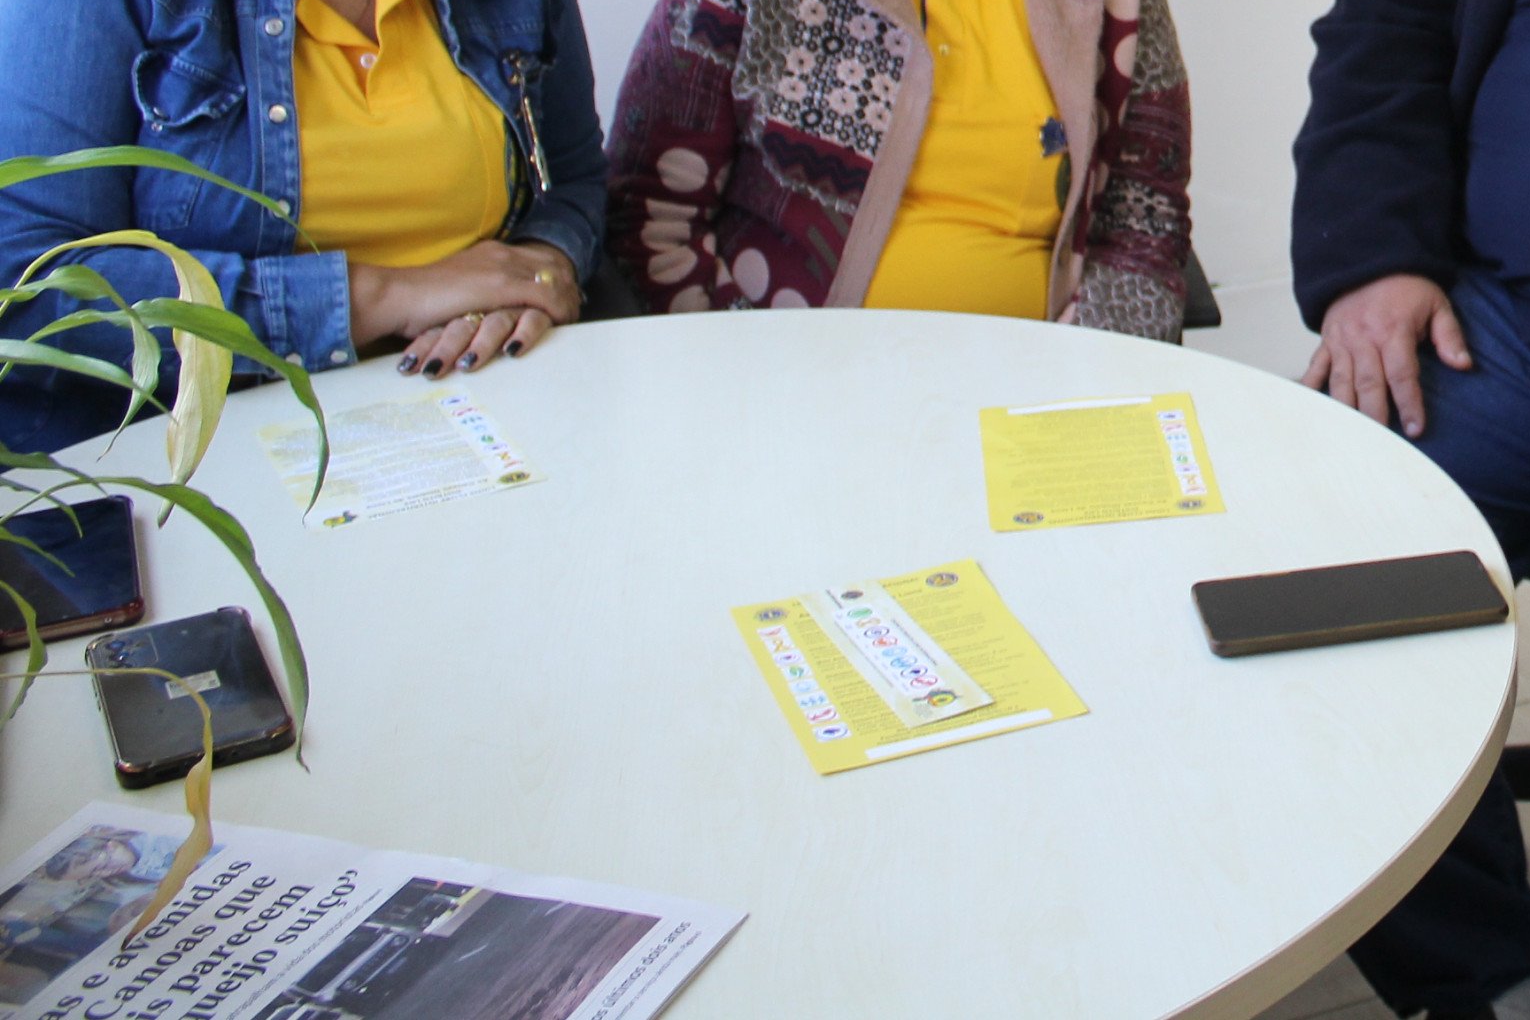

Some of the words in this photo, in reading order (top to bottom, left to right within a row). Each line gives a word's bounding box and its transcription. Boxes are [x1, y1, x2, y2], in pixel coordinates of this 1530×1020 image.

[82, 973, 111, 989] e
[109, 860, 252, 970] avenidas
[84, 924, 217, 1020] Canoas
[214, 876, 277, 921] que
[167, 883, 315, 995] parecem
